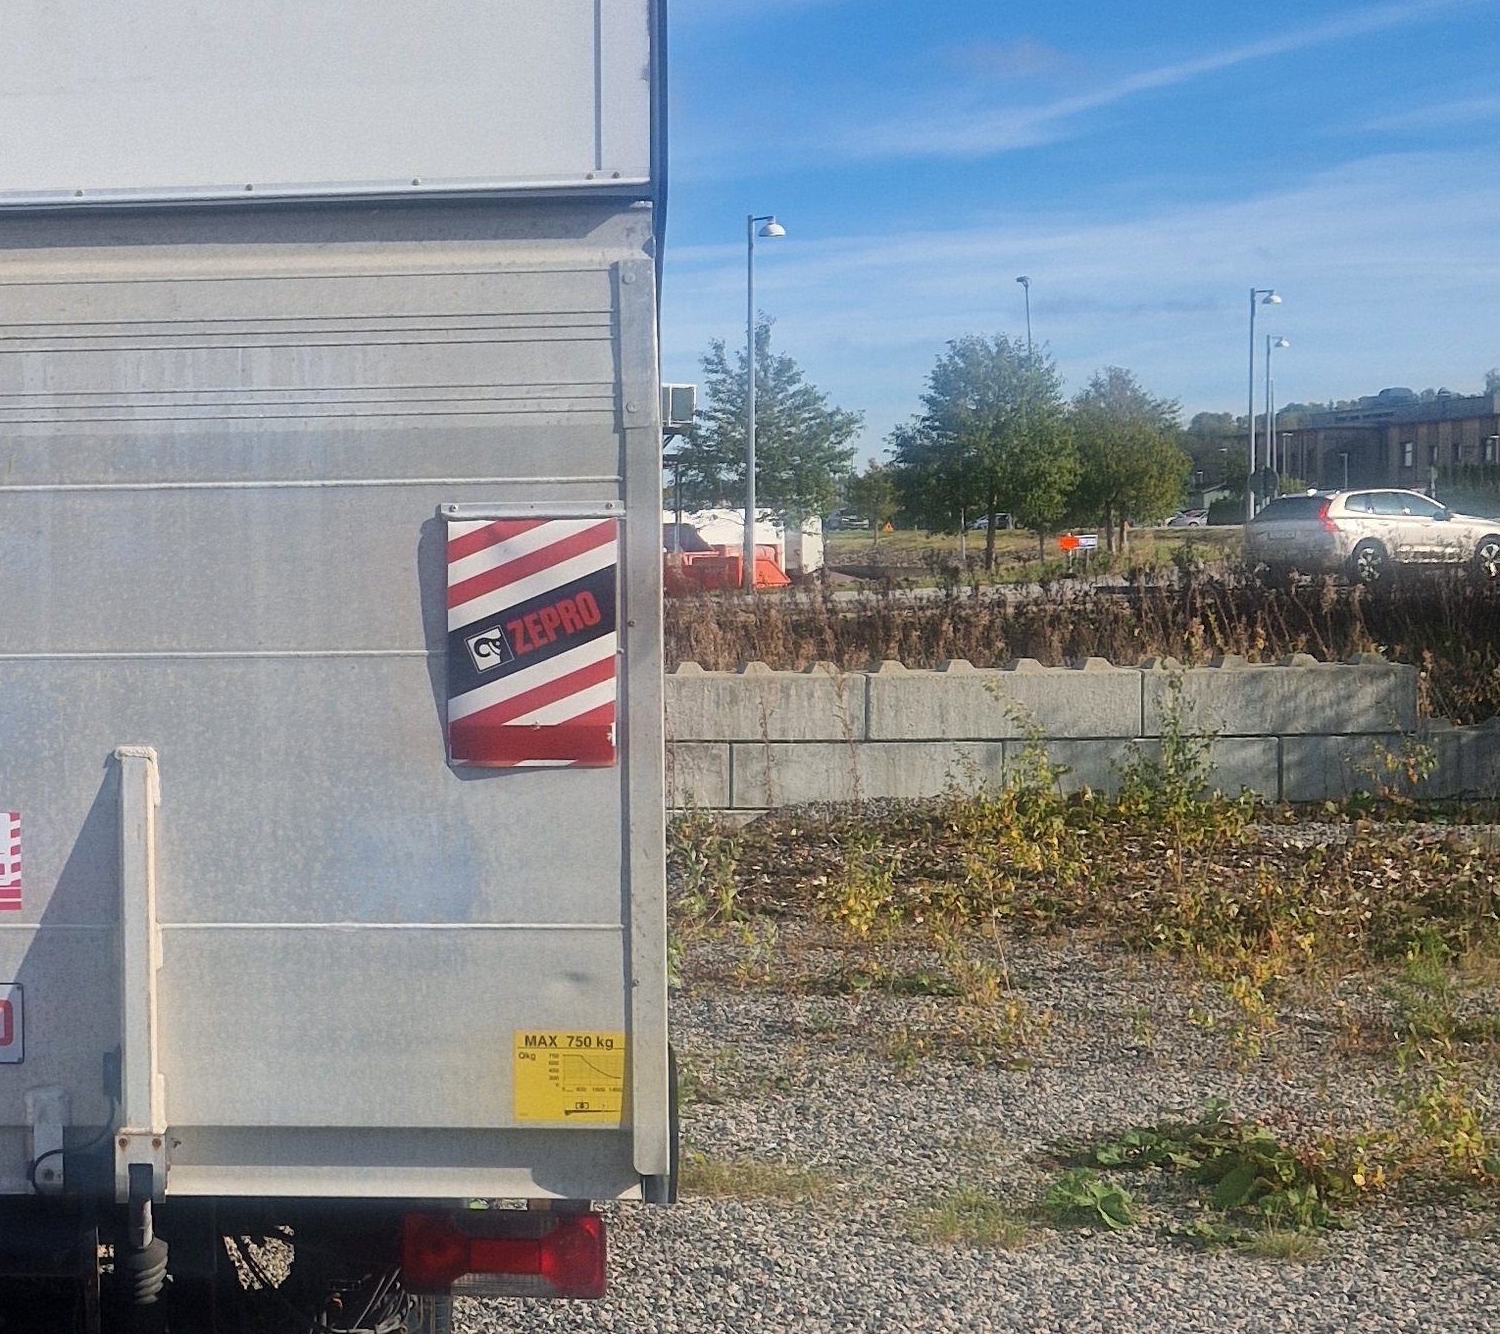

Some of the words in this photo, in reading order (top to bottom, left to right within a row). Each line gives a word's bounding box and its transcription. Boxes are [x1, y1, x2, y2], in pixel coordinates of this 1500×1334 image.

[506, 590, 602, 656] ZEPRO
[524, 1035, 558, 1047] MAX
[567, 1036, 592, 1048] 750
[596, 1035, 614, 1051] kg
